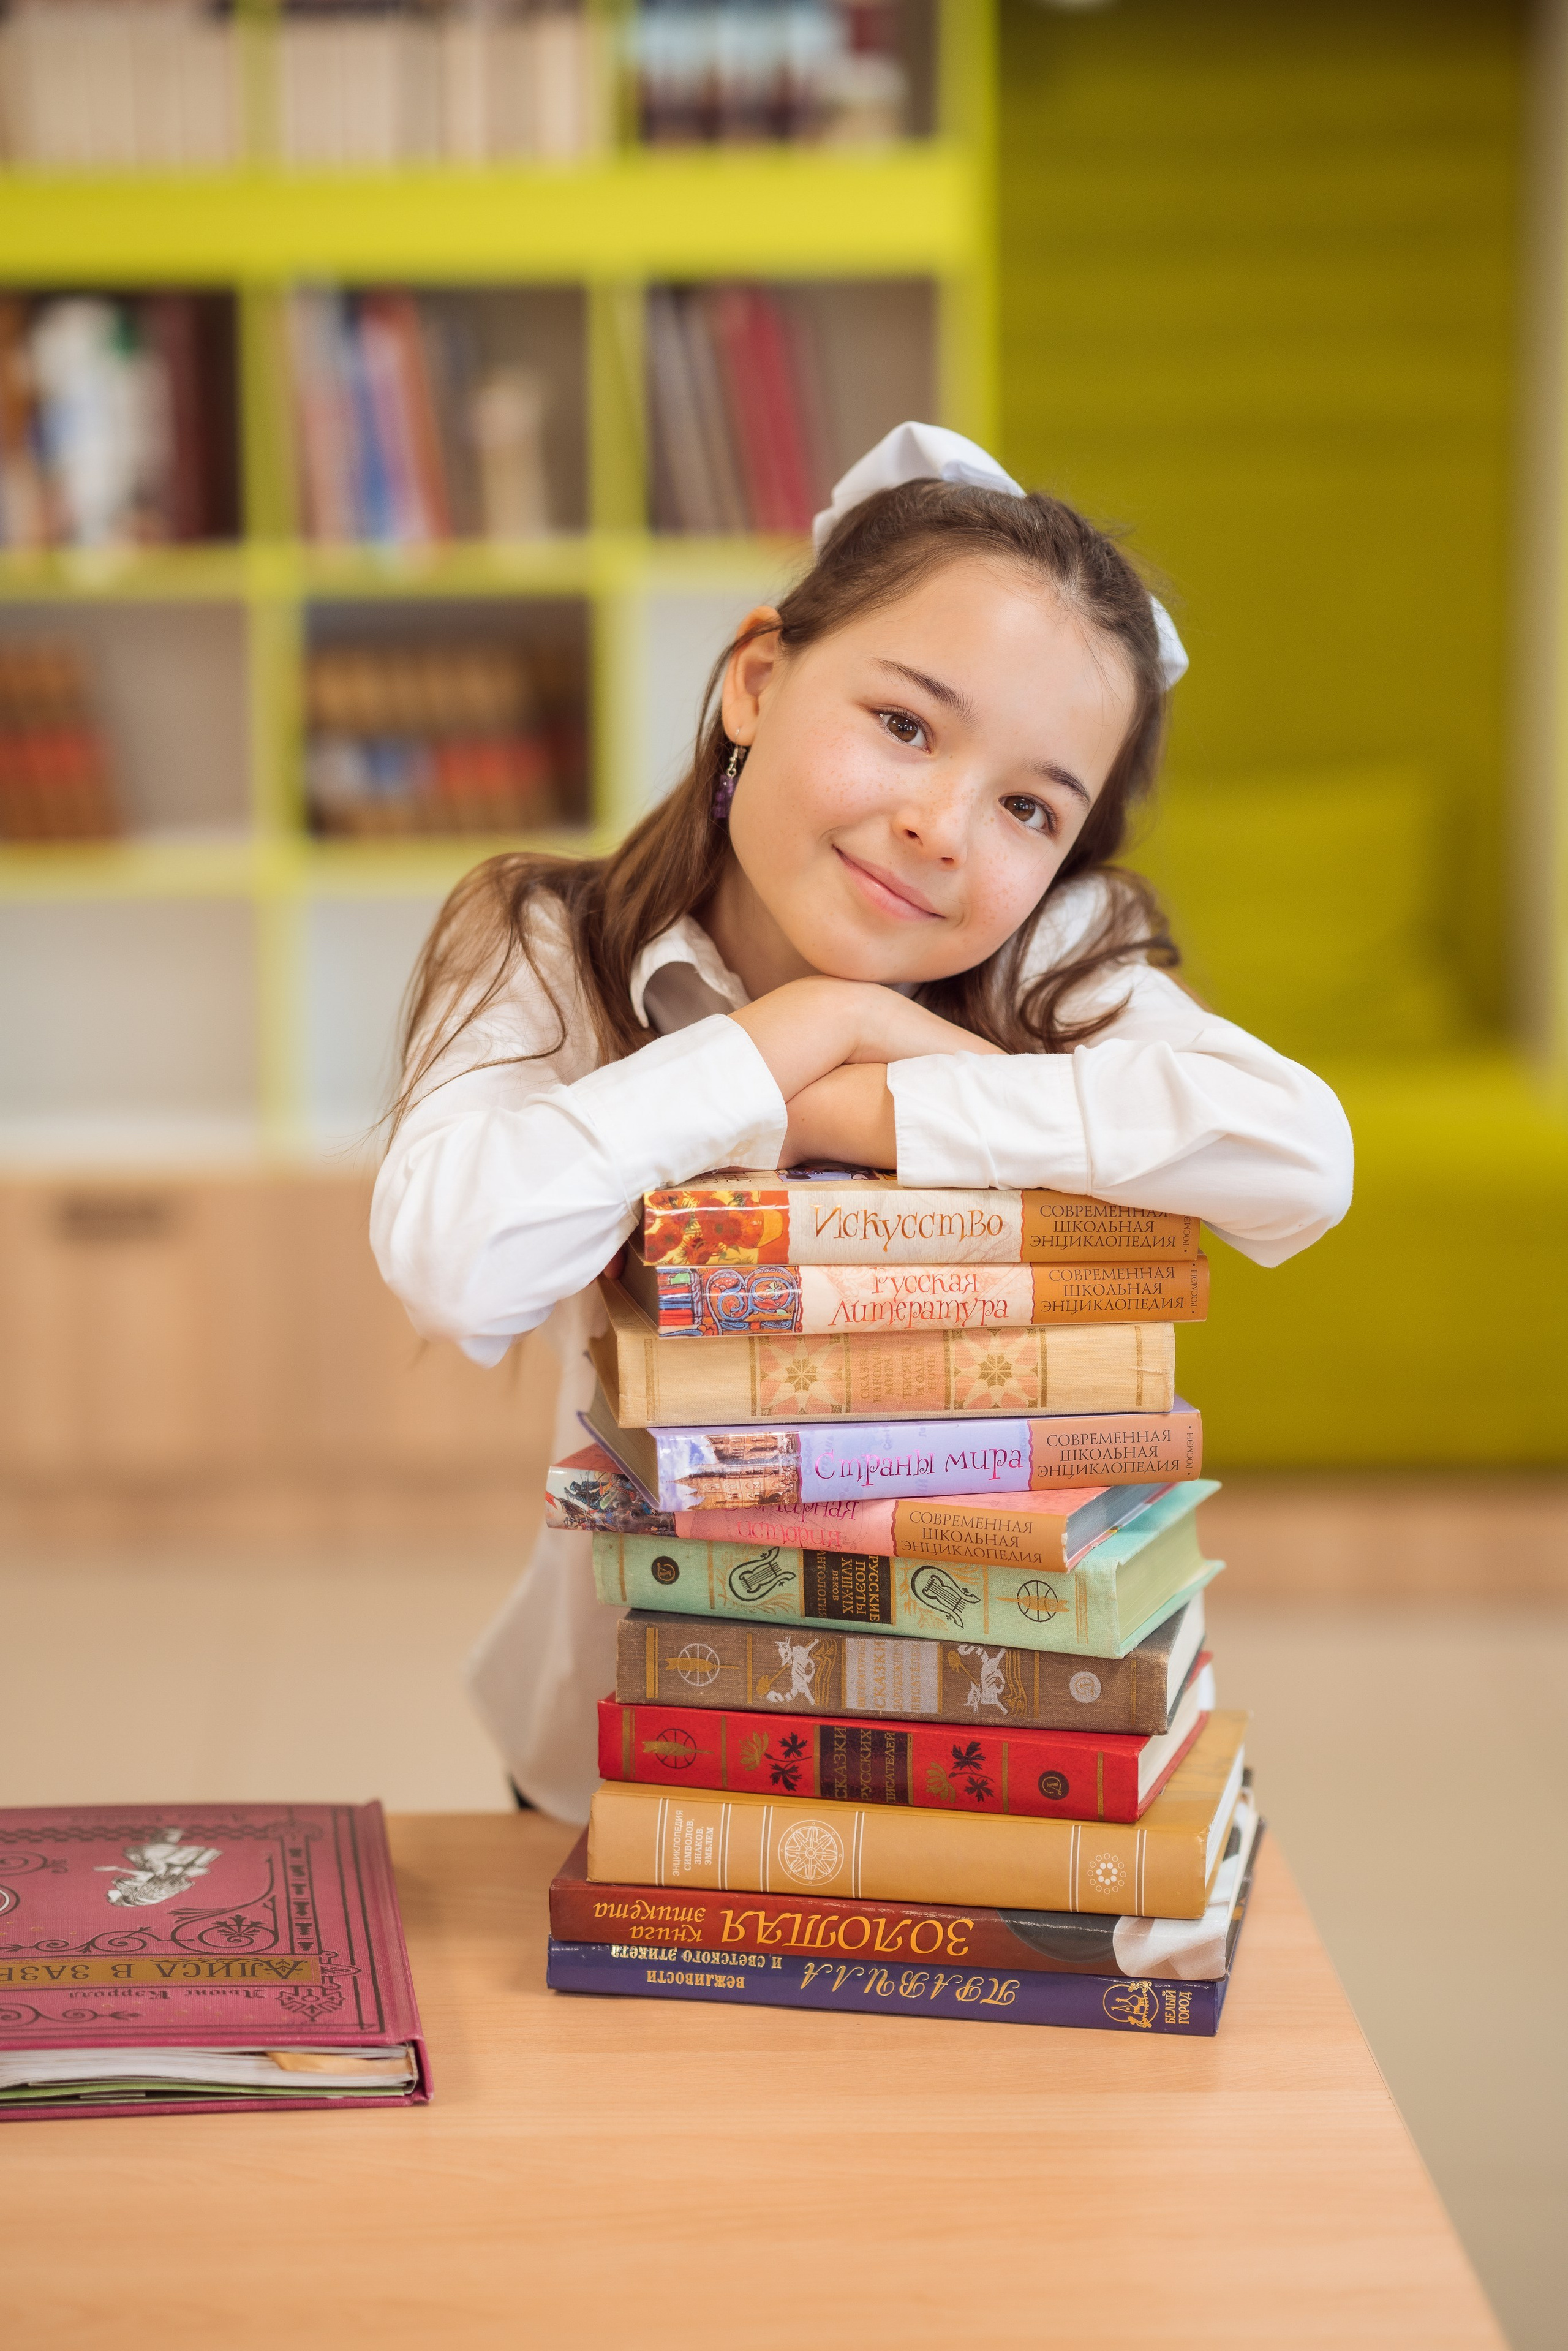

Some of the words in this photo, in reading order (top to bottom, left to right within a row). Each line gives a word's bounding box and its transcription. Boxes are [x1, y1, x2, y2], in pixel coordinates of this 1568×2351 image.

[810, 1204, 1003, 1253] Искусство
[1054, 1220, 1154, 1232] ШКОЛЬНАЯ
[1182, 1215, 1191, 1246] РОСМЭ
[1030, 1235, 1176, 1250] ЭНЦИКЛОПЕДИЯ
[869, 1267, 978, 1303] Русская
[1049, 1266, 1175, 1281] СОВРЕМЕННАЯ
[1190, 1269, 1199, 1307] РОСМЭН
[1063, 1282, 1163, 1297] ШКОЛЬНАЯ
[1041, 1297, 1184, 1315] ЭНЦИКЛОПЕДИЯ
[884, 1356, 894, 1395] МИРА
[927, 1354, 937, 1391] НОЧЬ
[1046, 1429, 1171, 1446] СОВРЕМЕННАЯ
[815, 1449, 935, 1487] Страны
[1060, 1446, 1158, 1462] ШКОЛЬНАЯ
[1038, 1460, 1180, 1479] ЭНЦИКЛОПЕДИЯ
[737, 1521, 842, 1548] история
[910, 1511, 1033, 1534] СОВРЕМЕННАЯ
[901, 1540, 1042, 1563] ЭНЦИКЛОПЕДИЯ
[922, 1528, 1019, 1547] ШКОЛЬНАЯ
[816, 1550, 827, 1618] АНТОЛОГИЯ
[856, 1561, 866, 1615] ПОЭТЫ
[869, 1555, 880, 1621] РУССКИЕ
[873, 1641, 886, 1709] СКАЗКИ
[834, 1726, 848, 1799] СКАЗКИ
[860, 1729, 872, 1802] РУССКИХ
[884, 1732, 896, 1803] ПИСАТЕЛЕЙ
[673, 1809, 684, 1877] ЭНЦИКЛОПЕДИЯ
[704, 1826, 714, 1865] ЭМБЛЕМ
[593, 1900, 706, 1923] этикета
[629, 1924, 703, 1942] книга
[719, 1909, 974, 1957] ЗОЛОТАЯ
[611, 1944, 677, 1962] этикета
[682, 1949, 766, 1969] светского
[111, 1963, 135, 1979] В
[153, 1959, 307, 1980] АЛИСА
[646, 1969, 745, 1989] вежливости
[1161, 1989, 1177, 2025] БЕЛЫЙ
[1178, 1991, 1193, 2025] ГОРОД
